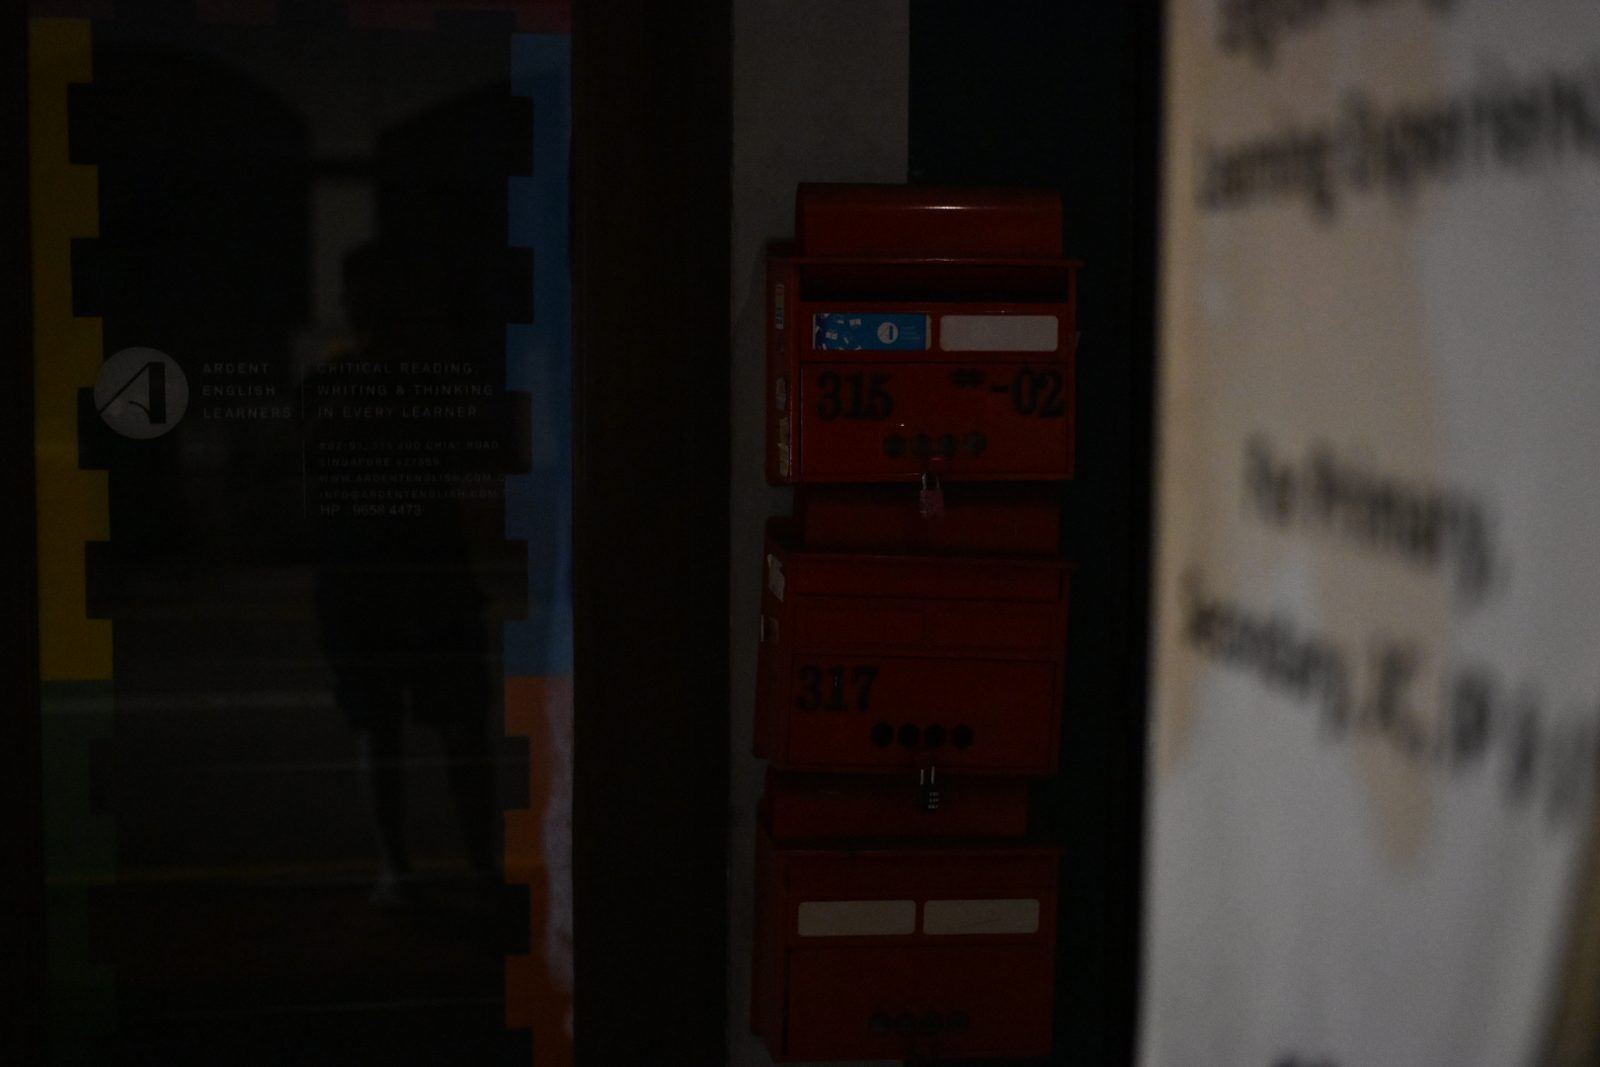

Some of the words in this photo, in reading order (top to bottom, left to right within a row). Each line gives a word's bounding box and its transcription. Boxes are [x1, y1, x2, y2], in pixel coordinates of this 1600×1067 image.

[202, 362, 269, 374] ARDENT
[317, 362, 392, 375] CRITICAL
[400, 362, 480, 376] READING,
[202, 384, 276, 397] ENGLISH
[317, 384, 388, 397] WRITING
[395, 384, 406, 397] &
[414, 384, 494, 397] THINKING
[816, 370, 895, 422] 315
[202, 407, 292, 419] LEARNERS
[317, 406, 334, 418] IN
[343, 406, 394, 418] EVERY
[402, 406, 477, 418] LEARNER
[466, 440, 499, 450] ROAD
[319, 456, 390, 467] SINGAPORE
[320, 504, 341, 517] HP
[389, 504, 423, 517] 4473
[794, 663, 880, 713] 317
